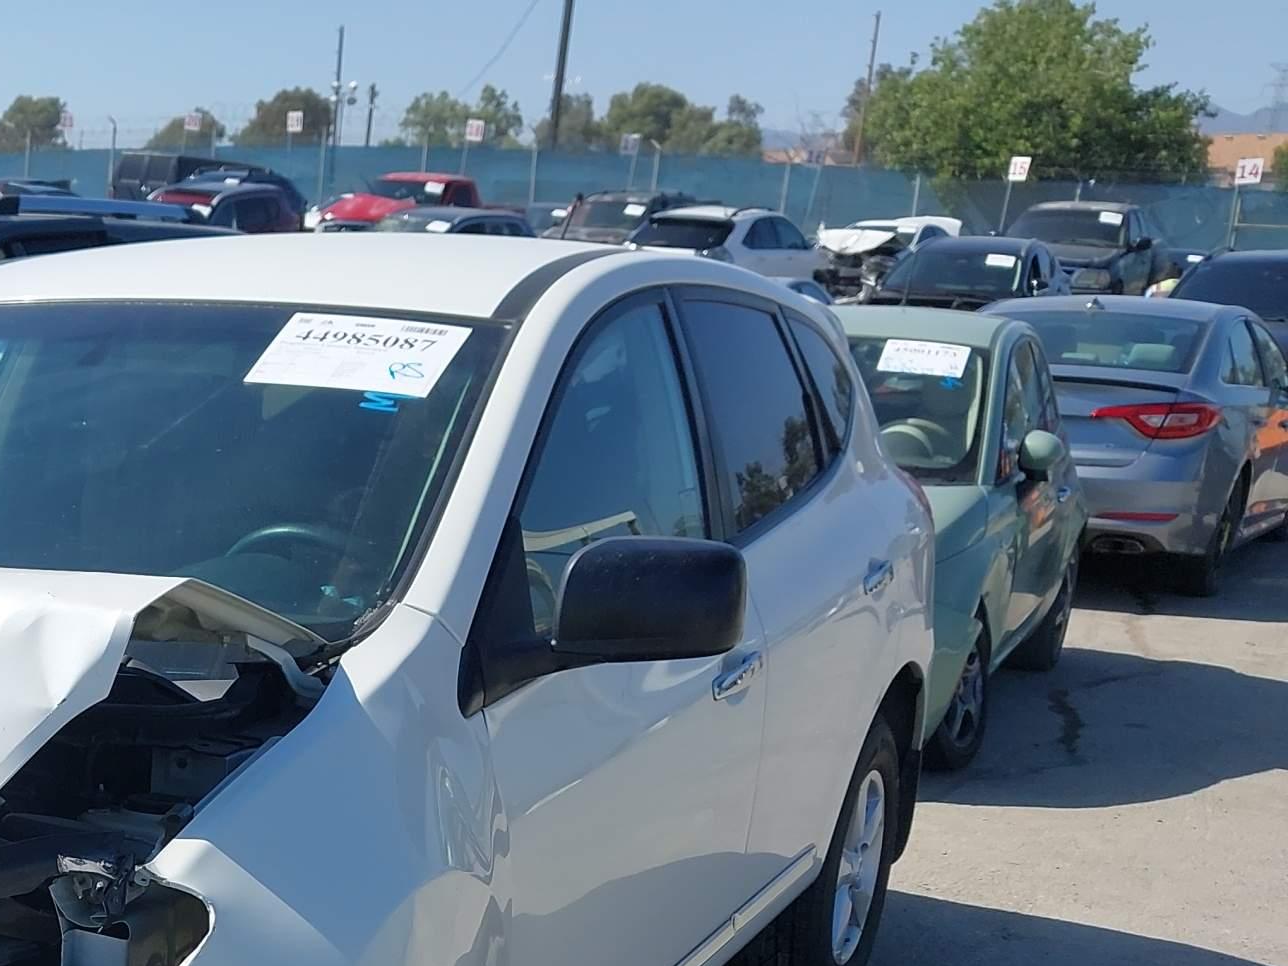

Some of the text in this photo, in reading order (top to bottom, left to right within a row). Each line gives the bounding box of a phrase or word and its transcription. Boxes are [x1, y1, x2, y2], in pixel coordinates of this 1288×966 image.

[1009, 161, 1028, 175] 15
[1237, 164, 1259, 178] 14
[295, 328, 438, 351] 44985087
